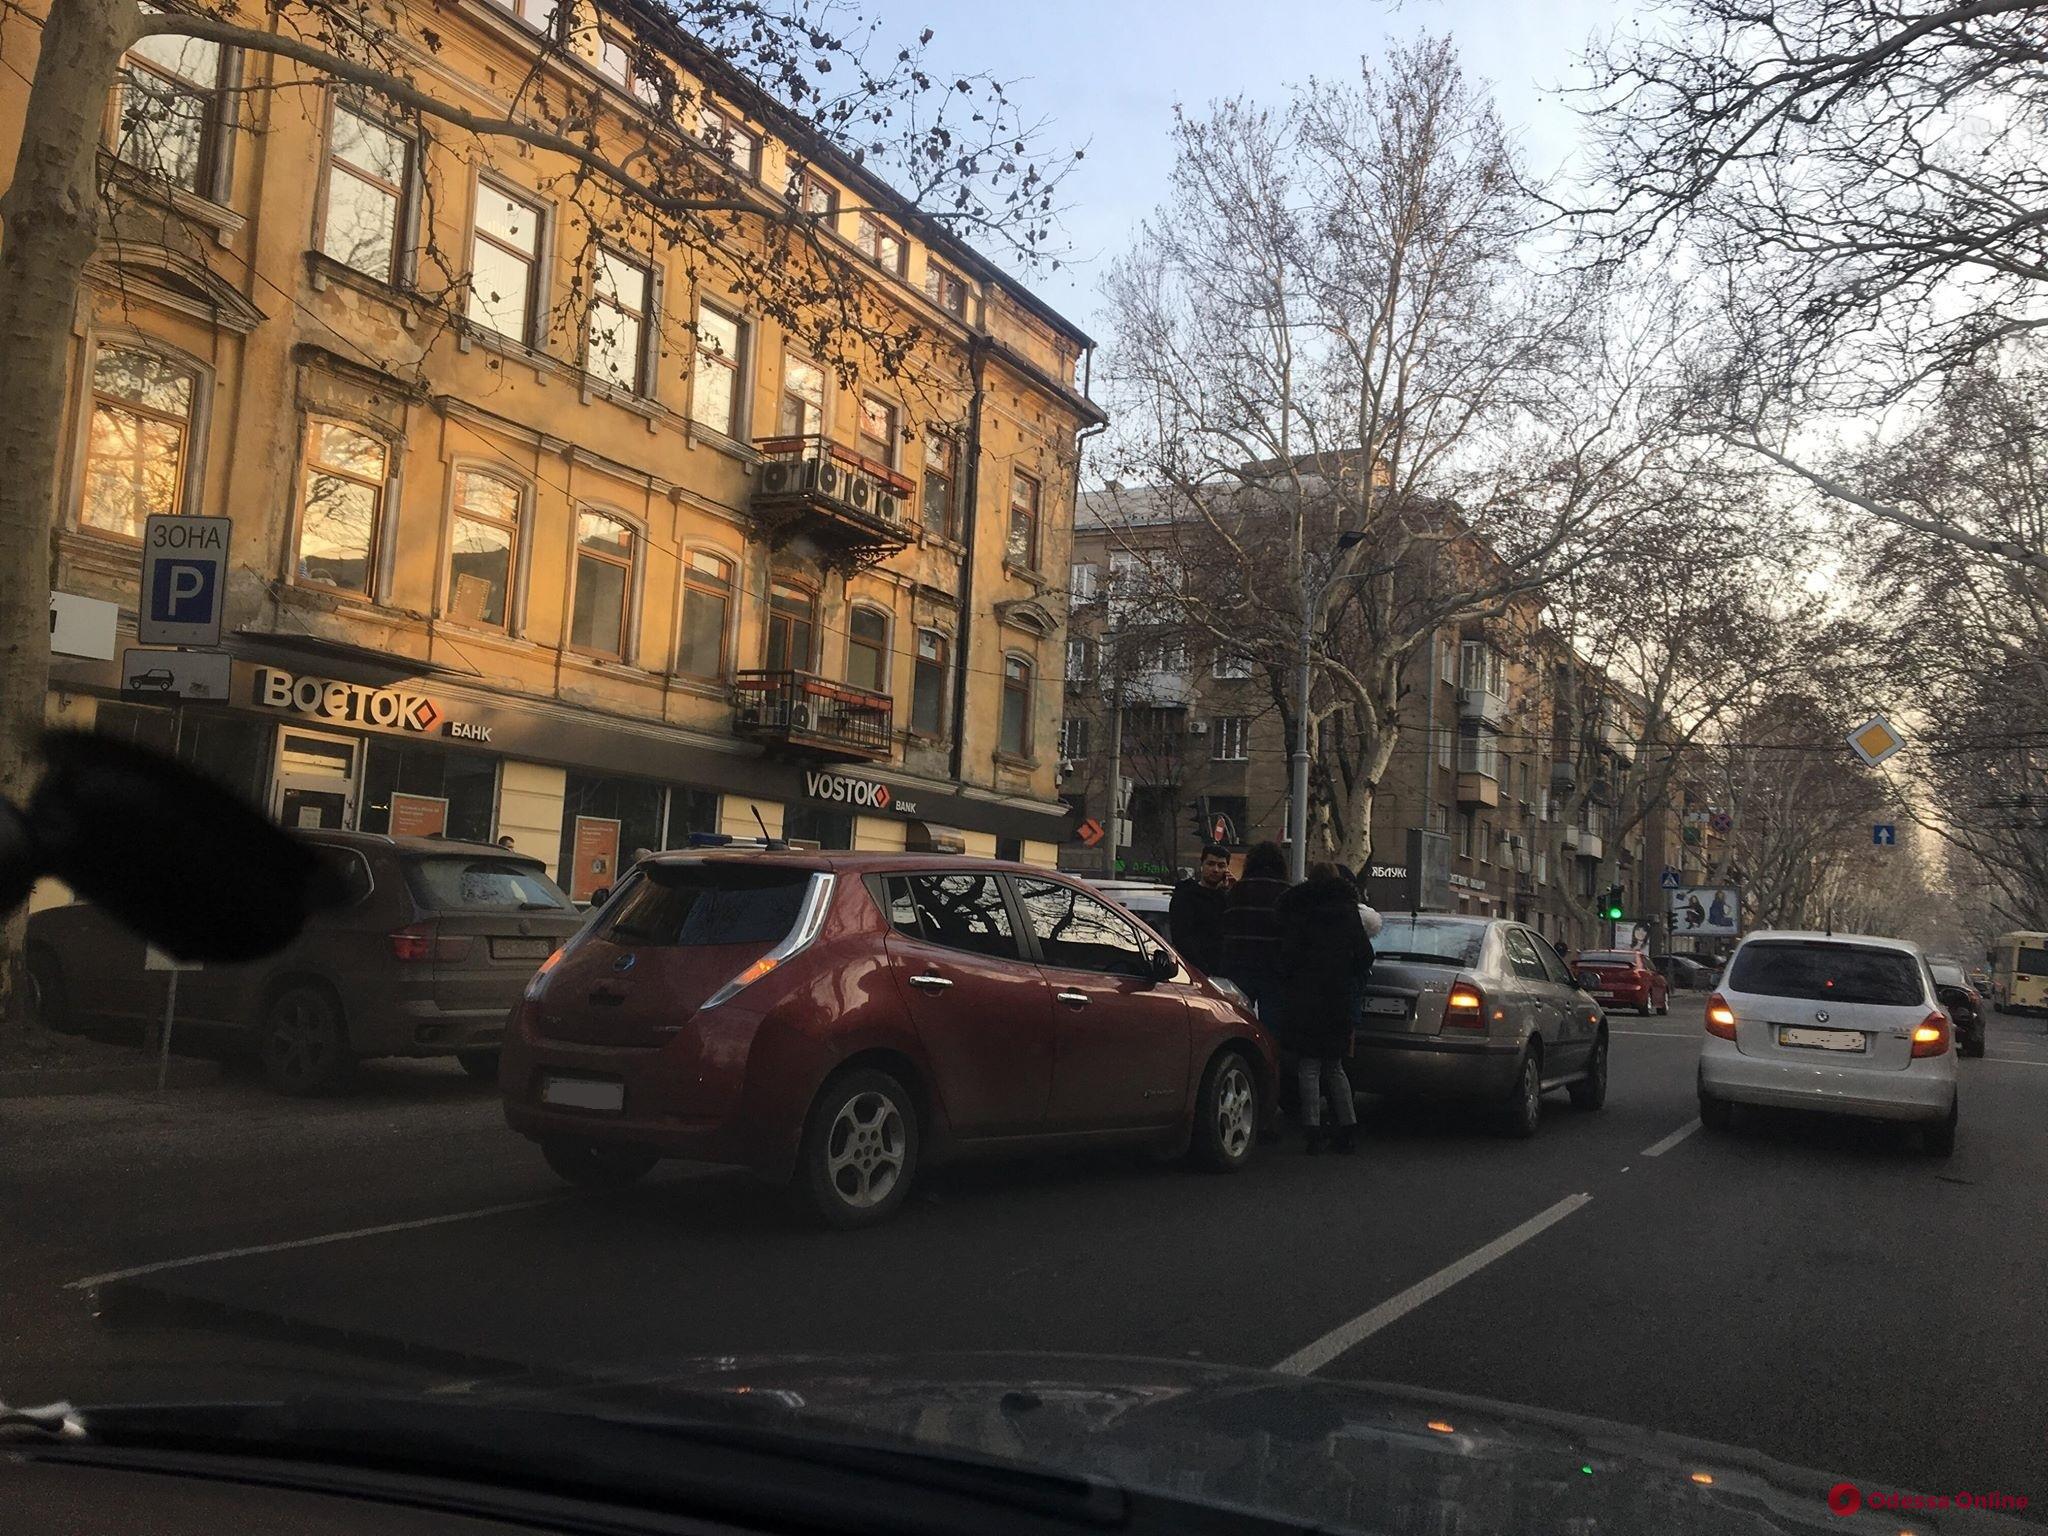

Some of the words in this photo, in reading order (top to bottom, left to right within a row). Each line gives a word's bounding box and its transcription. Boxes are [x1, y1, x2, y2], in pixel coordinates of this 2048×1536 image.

[153, 525, 221, 549] ЗОНА
[168, 565, 204, 616] P
[263, 668, 427, 731] ВОСТОК
[451, 721, 493, 742] БАНК
[806, 771, 882, 808] VOSTOK
[895, 800, 917, 814] BANK
